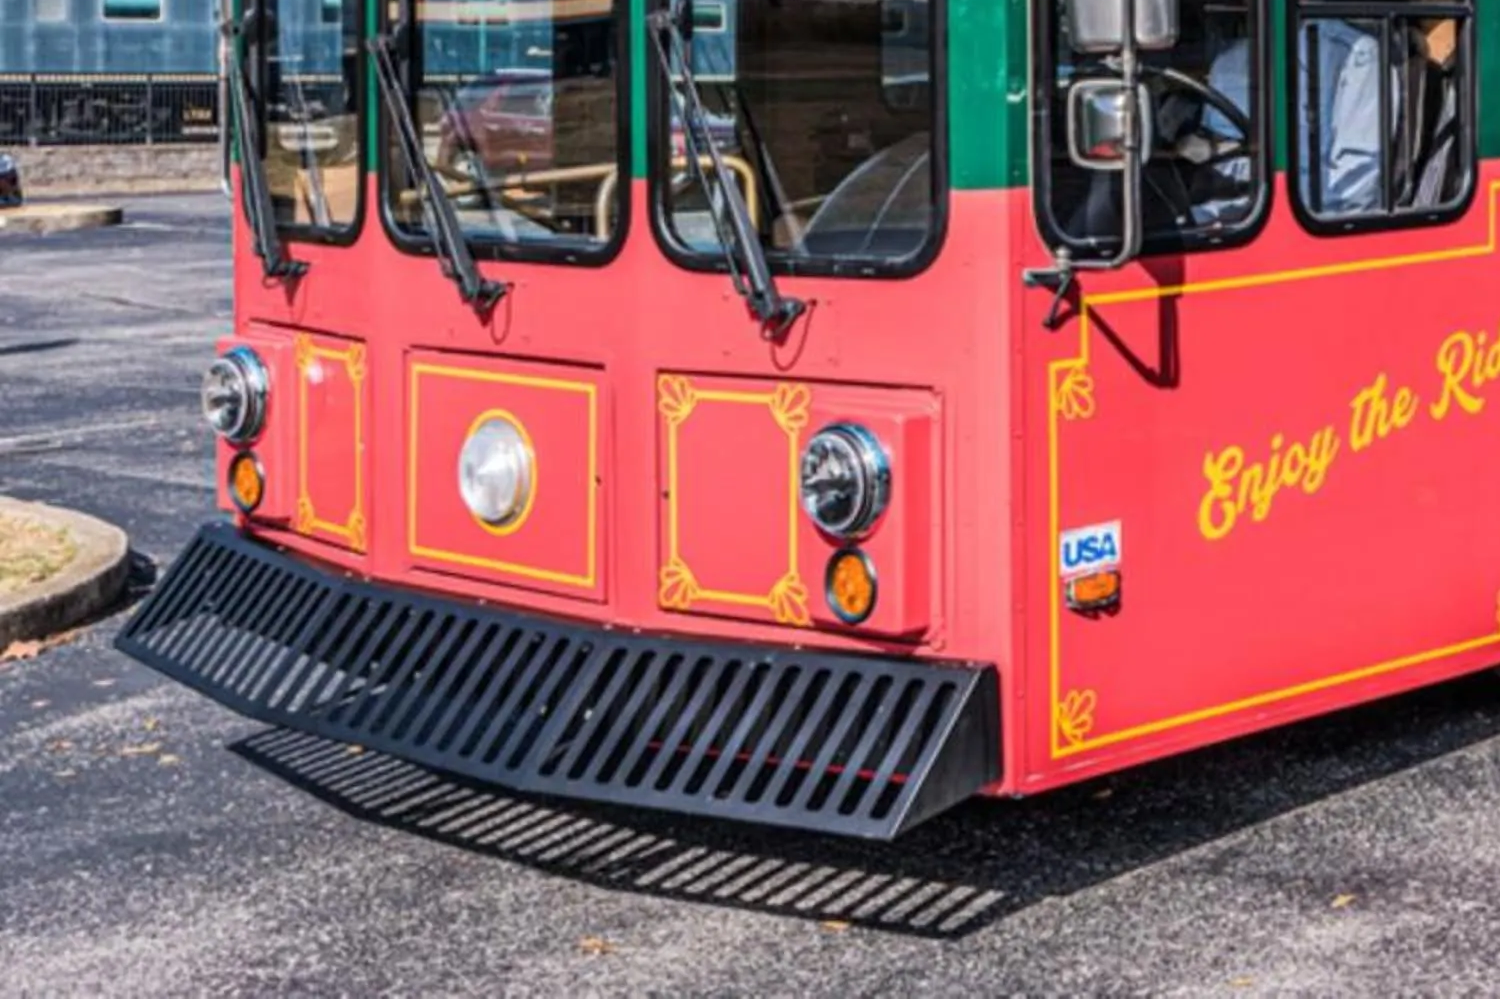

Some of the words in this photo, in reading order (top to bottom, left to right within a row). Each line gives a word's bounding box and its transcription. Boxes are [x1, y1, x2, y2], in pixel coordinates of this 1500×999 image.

[1197, 424, 1341, 540] Enjoy
[1349, 371, 1419, 452] the
[1063, 532, 1117, 568] USA
